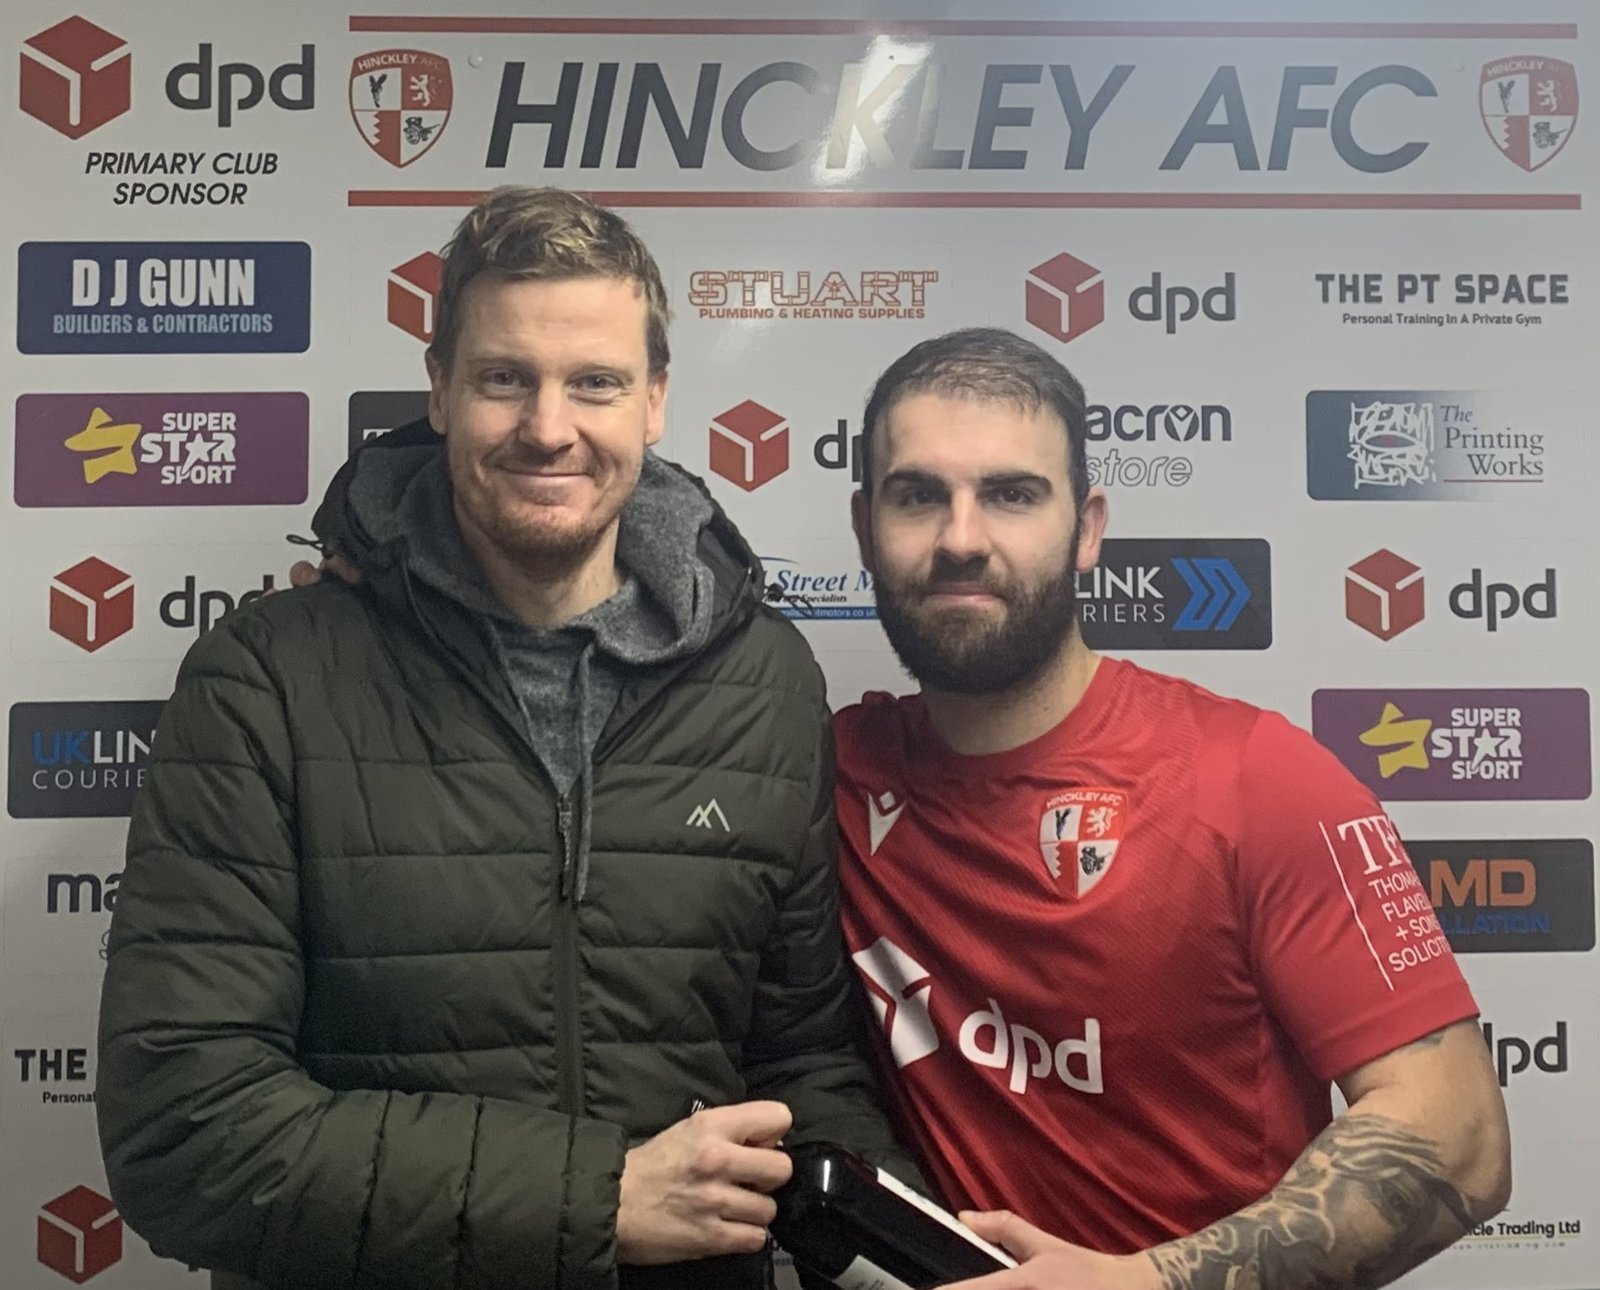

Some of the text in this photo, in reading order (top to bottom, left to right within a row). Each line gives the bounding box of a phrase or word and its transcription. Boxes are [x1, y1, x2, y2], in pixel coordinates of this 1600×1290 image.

[357, 53, 418, 71] HINCKLEY
[165, 43, 315, 128] dpd
[485, 61, 1438, 174] HINCKLEY AFC
[85, 152, 278, 175] PRIMARY CLUB
[113, 182, 248, 206] SPONSOR
[72, 258, 256, 307] D J GUNN
[688, 271, 938, 306] STUART
[1315, 273, 1569, 304] THE PT SPACE
[700, 308, 925, 319] PLUMBING & HEATING SUPPLIES
[1128, 271, 1236, 334] dpd
[53, 313, 273, 334] BUILDERS & CONTRACTORS
[1342, 313, 1542, 328] Personal Training In A Private Gym
[162, 412, 236, 432] SUPER
[1440, 405, 1473, 423] The
[140, 432, 236, 463] STAR
[1444, 428, 1544, 455] Printing
[161, 465, 236, 485] SPORT
[1087, 448, 1193, 487] store
[1467, 454, 1544, 476] Works
[777, 570, 848, 592] Street
[1449, 568, 1557, 631] dpd
[1083, 603, 1165, 623] RIERS
[1451, 708, 1521, 727] SUPER
[1431, 728, 1522, 758] STAR
[1452, 760, 1522, 780] SPORT
[1368, 869, 1423, 899] THOMA
[1430, 859, 1537, 907] MD
[959, 997, 1104, 1094] dpd
[15, 1048, 87, 1081] THE
[1469, 1220, 1580, 1239] cle Trading Ltd
